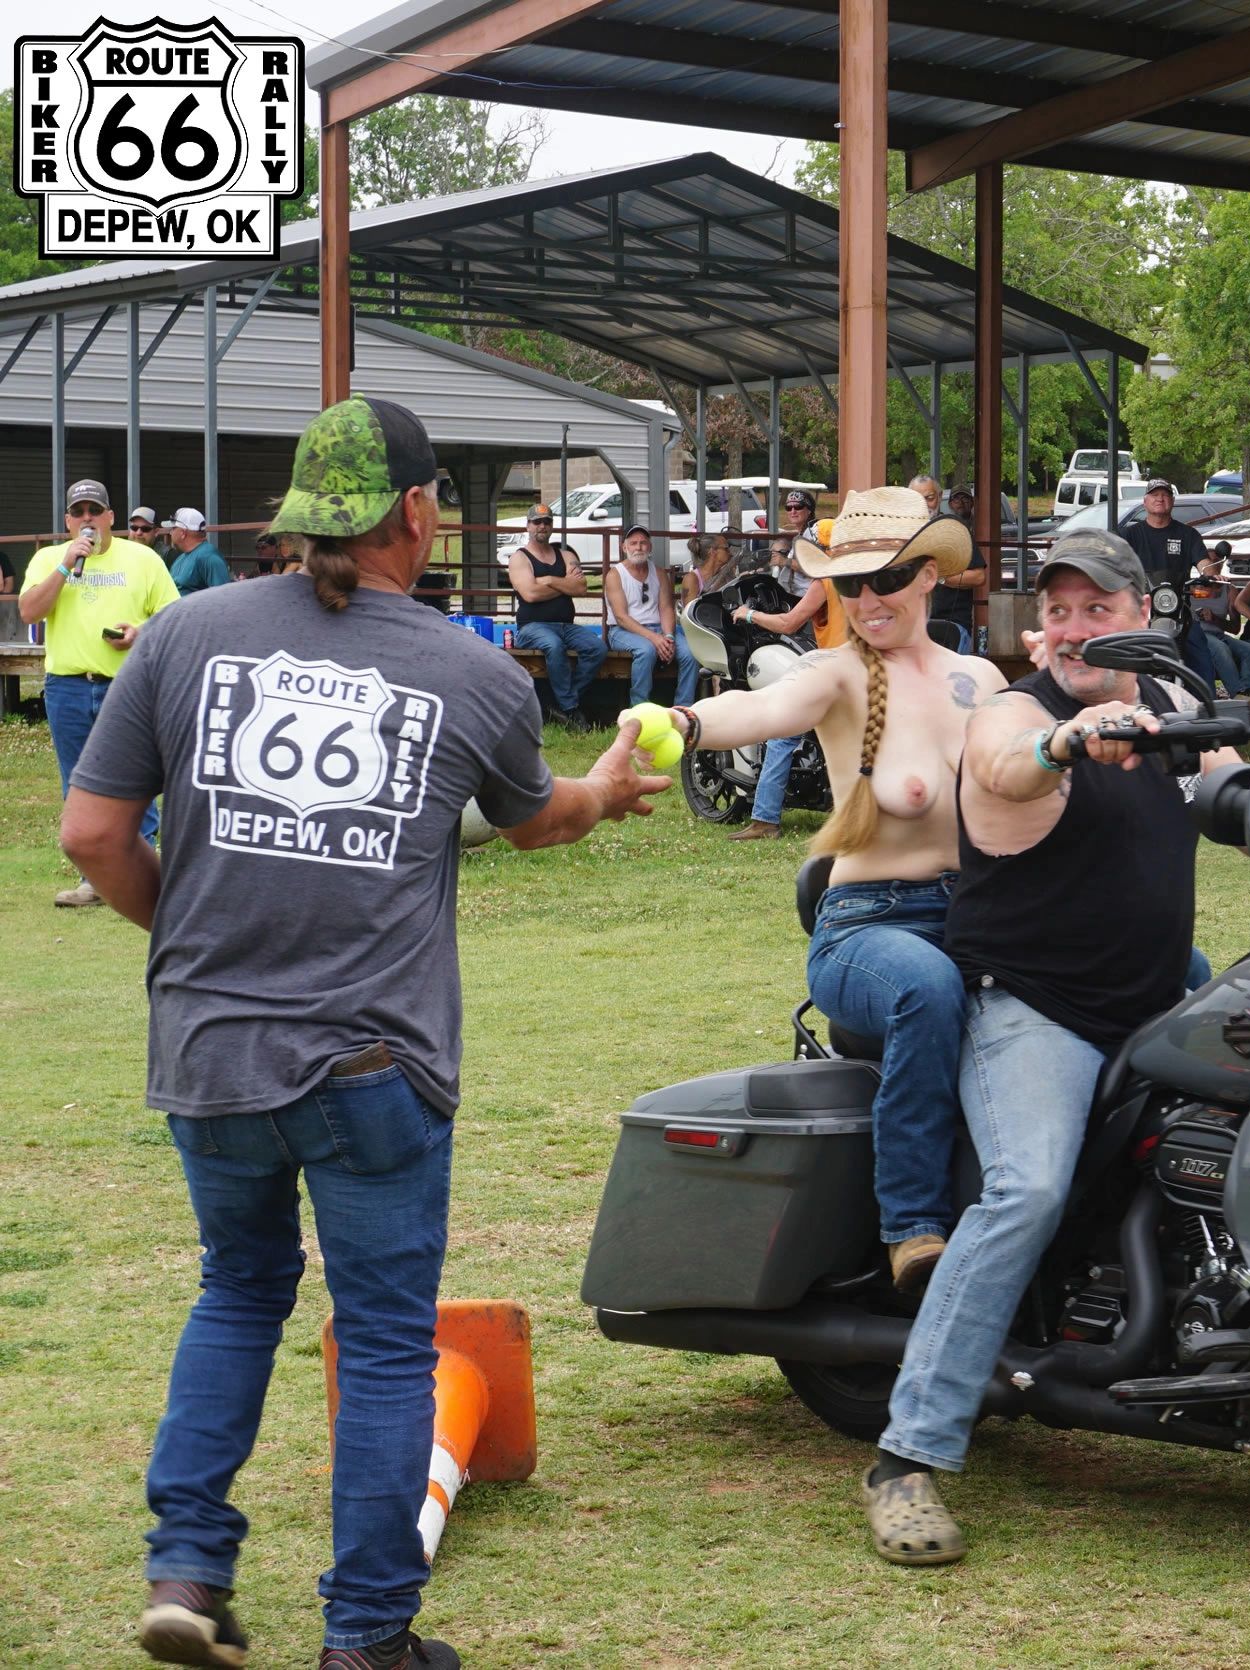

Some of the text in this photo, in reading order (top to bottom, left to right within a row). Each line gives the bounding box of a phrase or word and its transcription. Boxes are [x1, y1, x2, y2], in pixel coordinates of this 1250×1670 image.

[203, 663, 240, 777] BIKER
[276, 670, 370, 705] ROUTE
[259, 712, 360, 788] 66
[389, 696, 430, 803] RALLY
[216, 807, 391, 860] DEPEW, OK
